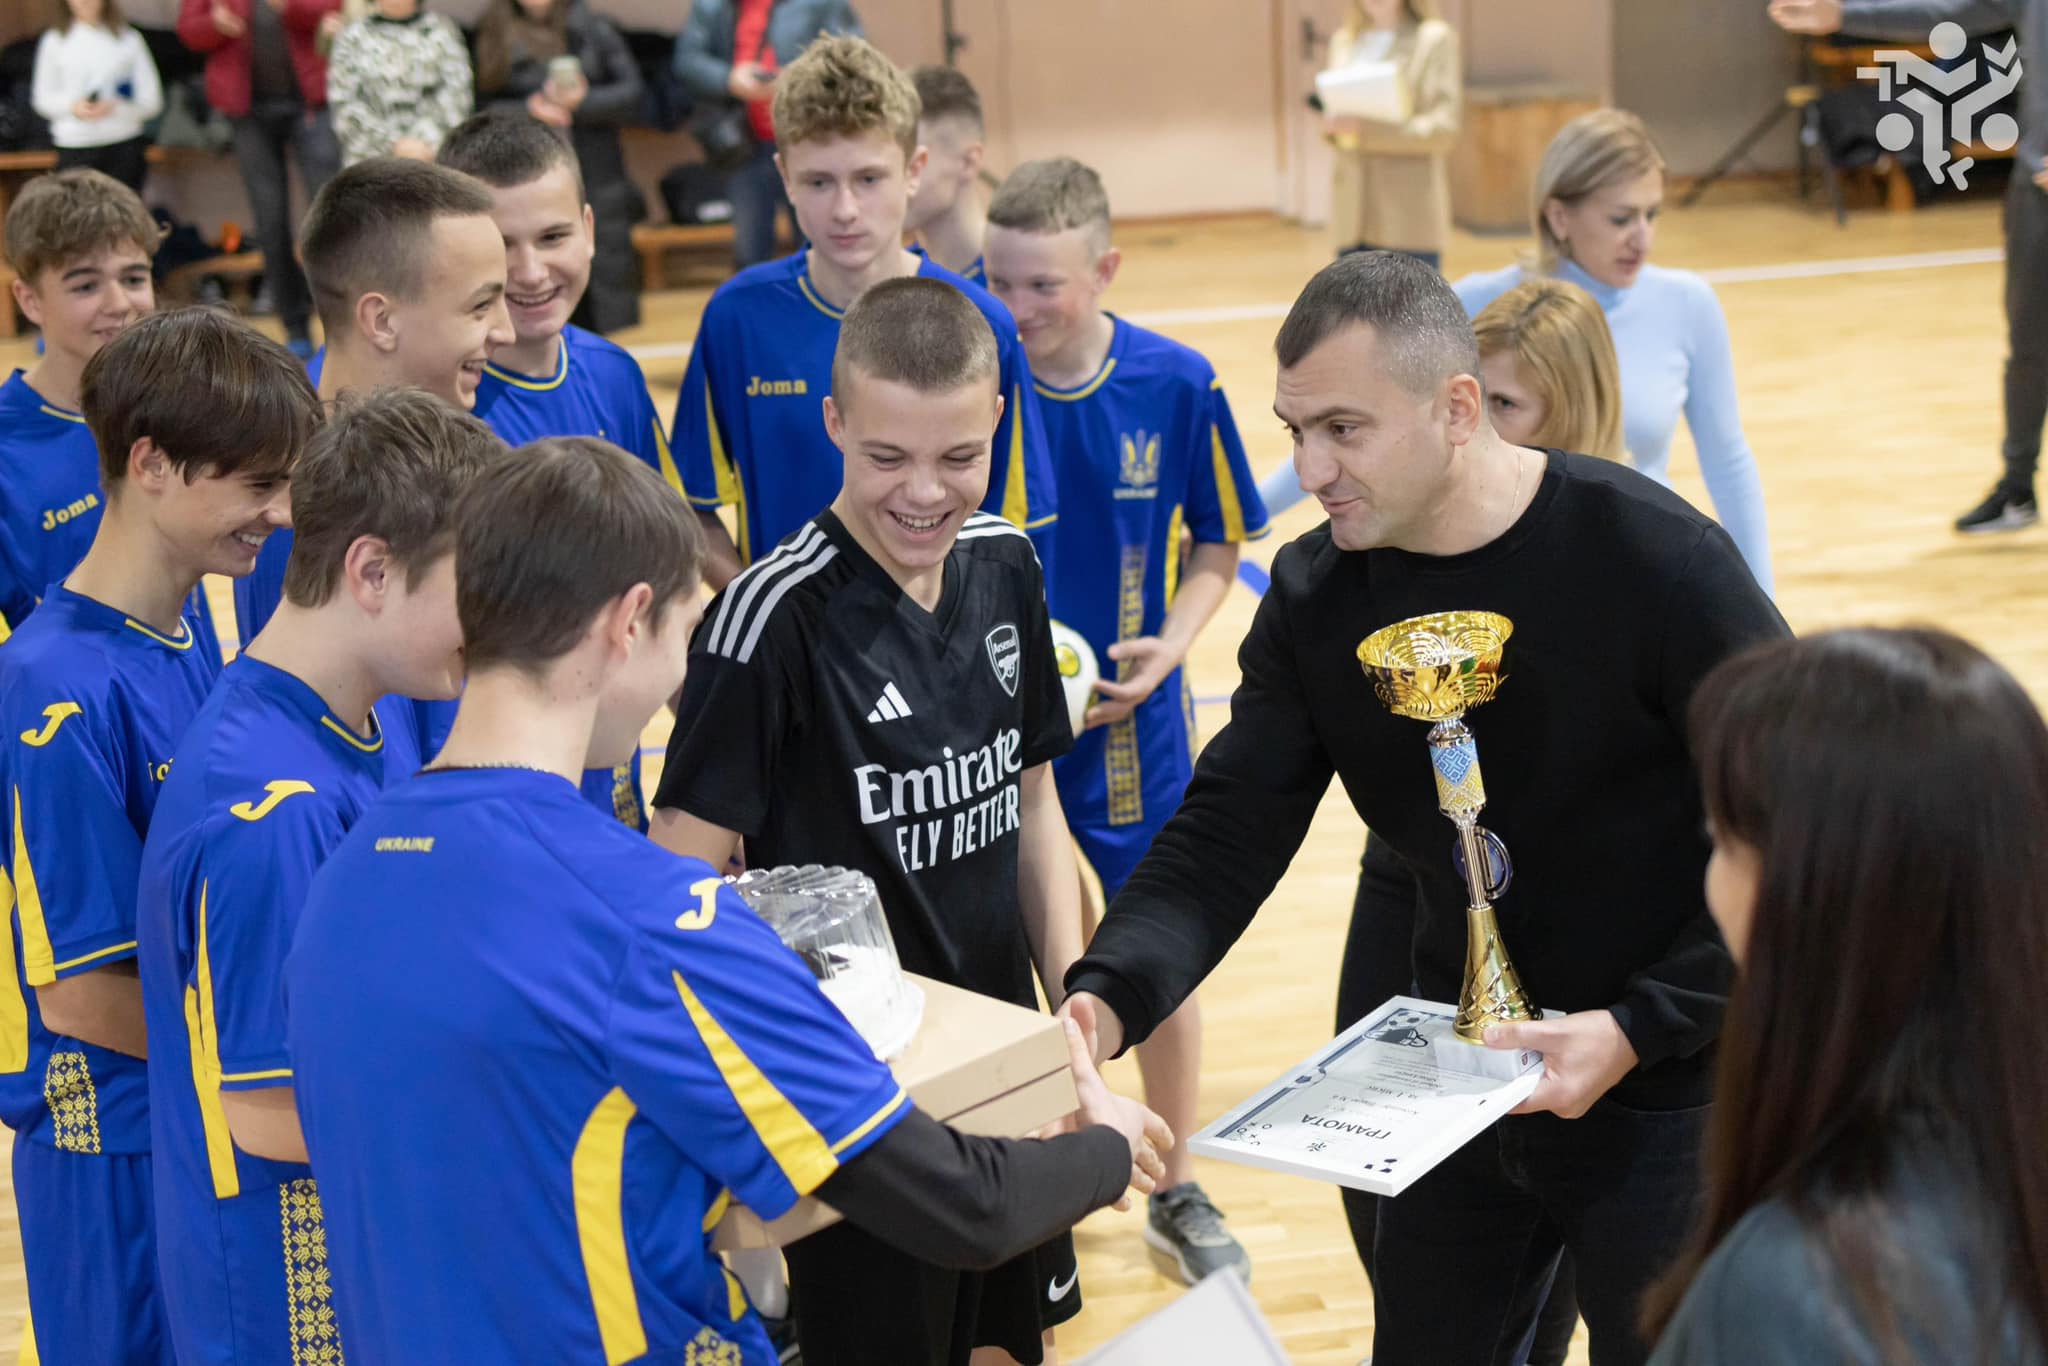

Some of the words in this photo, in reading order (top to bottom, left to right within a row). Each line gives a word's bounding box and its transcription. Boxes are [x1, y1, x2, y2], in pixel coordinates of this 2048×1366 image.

[746, 376, 807, 396] Joma
[42, 493, 99, 530] Joma
[951, 783, 1020, 861] BETTER
[375, 837, 435, 852] UKRAINE
[1301, 1114, 1391, 1140] ГРАМОТА
